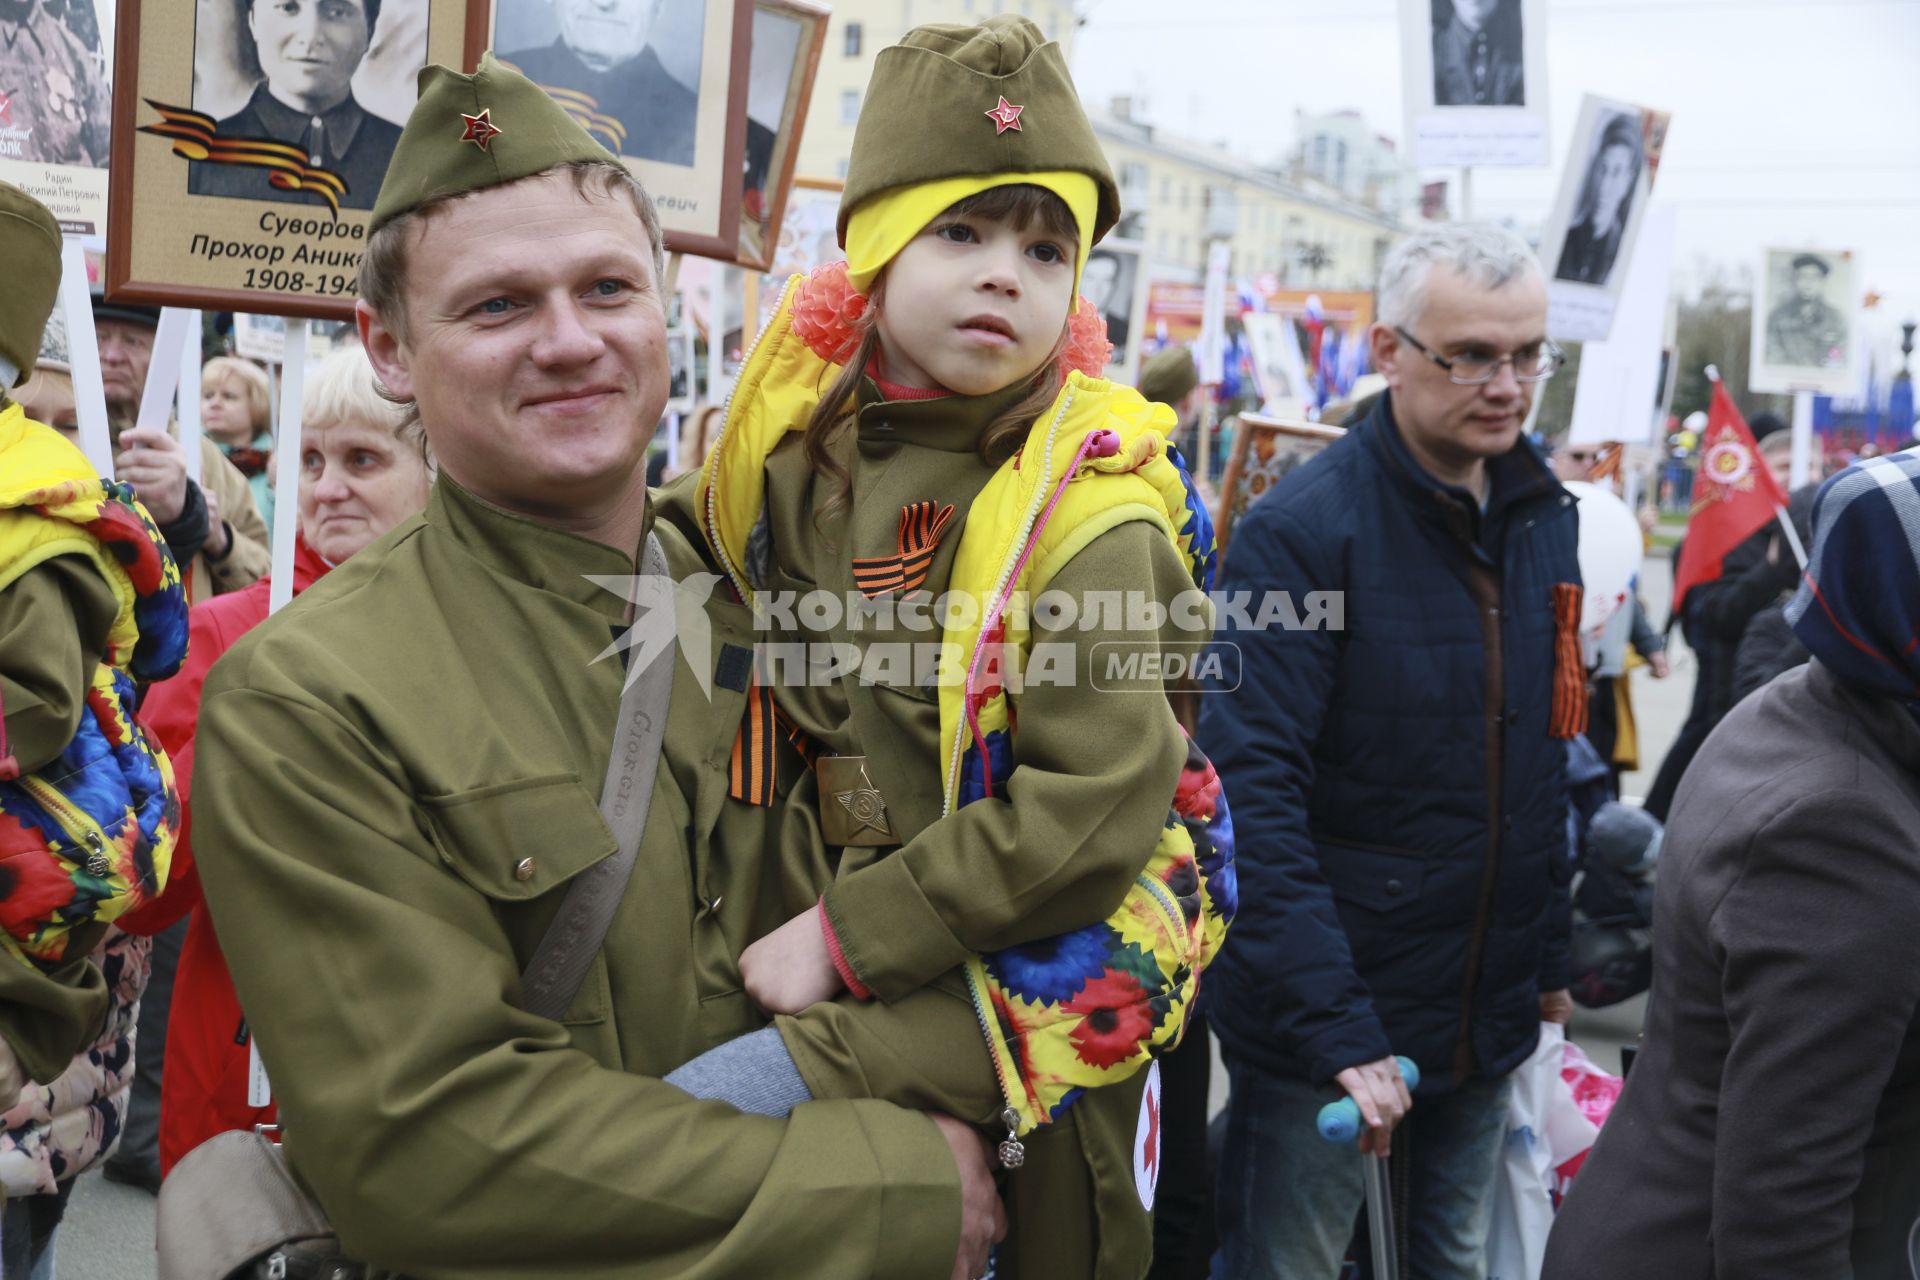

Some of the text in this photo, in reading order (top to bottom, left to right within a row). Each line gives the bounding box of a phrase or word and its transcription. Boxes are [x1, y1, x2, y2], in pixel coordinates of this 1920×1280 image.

[59, 186, 100, 200] Петрович
[654, 195, 698, 213] евич
[260, 211, 364, 241] Суворов
[190, 234, 285, 265] Прохор
